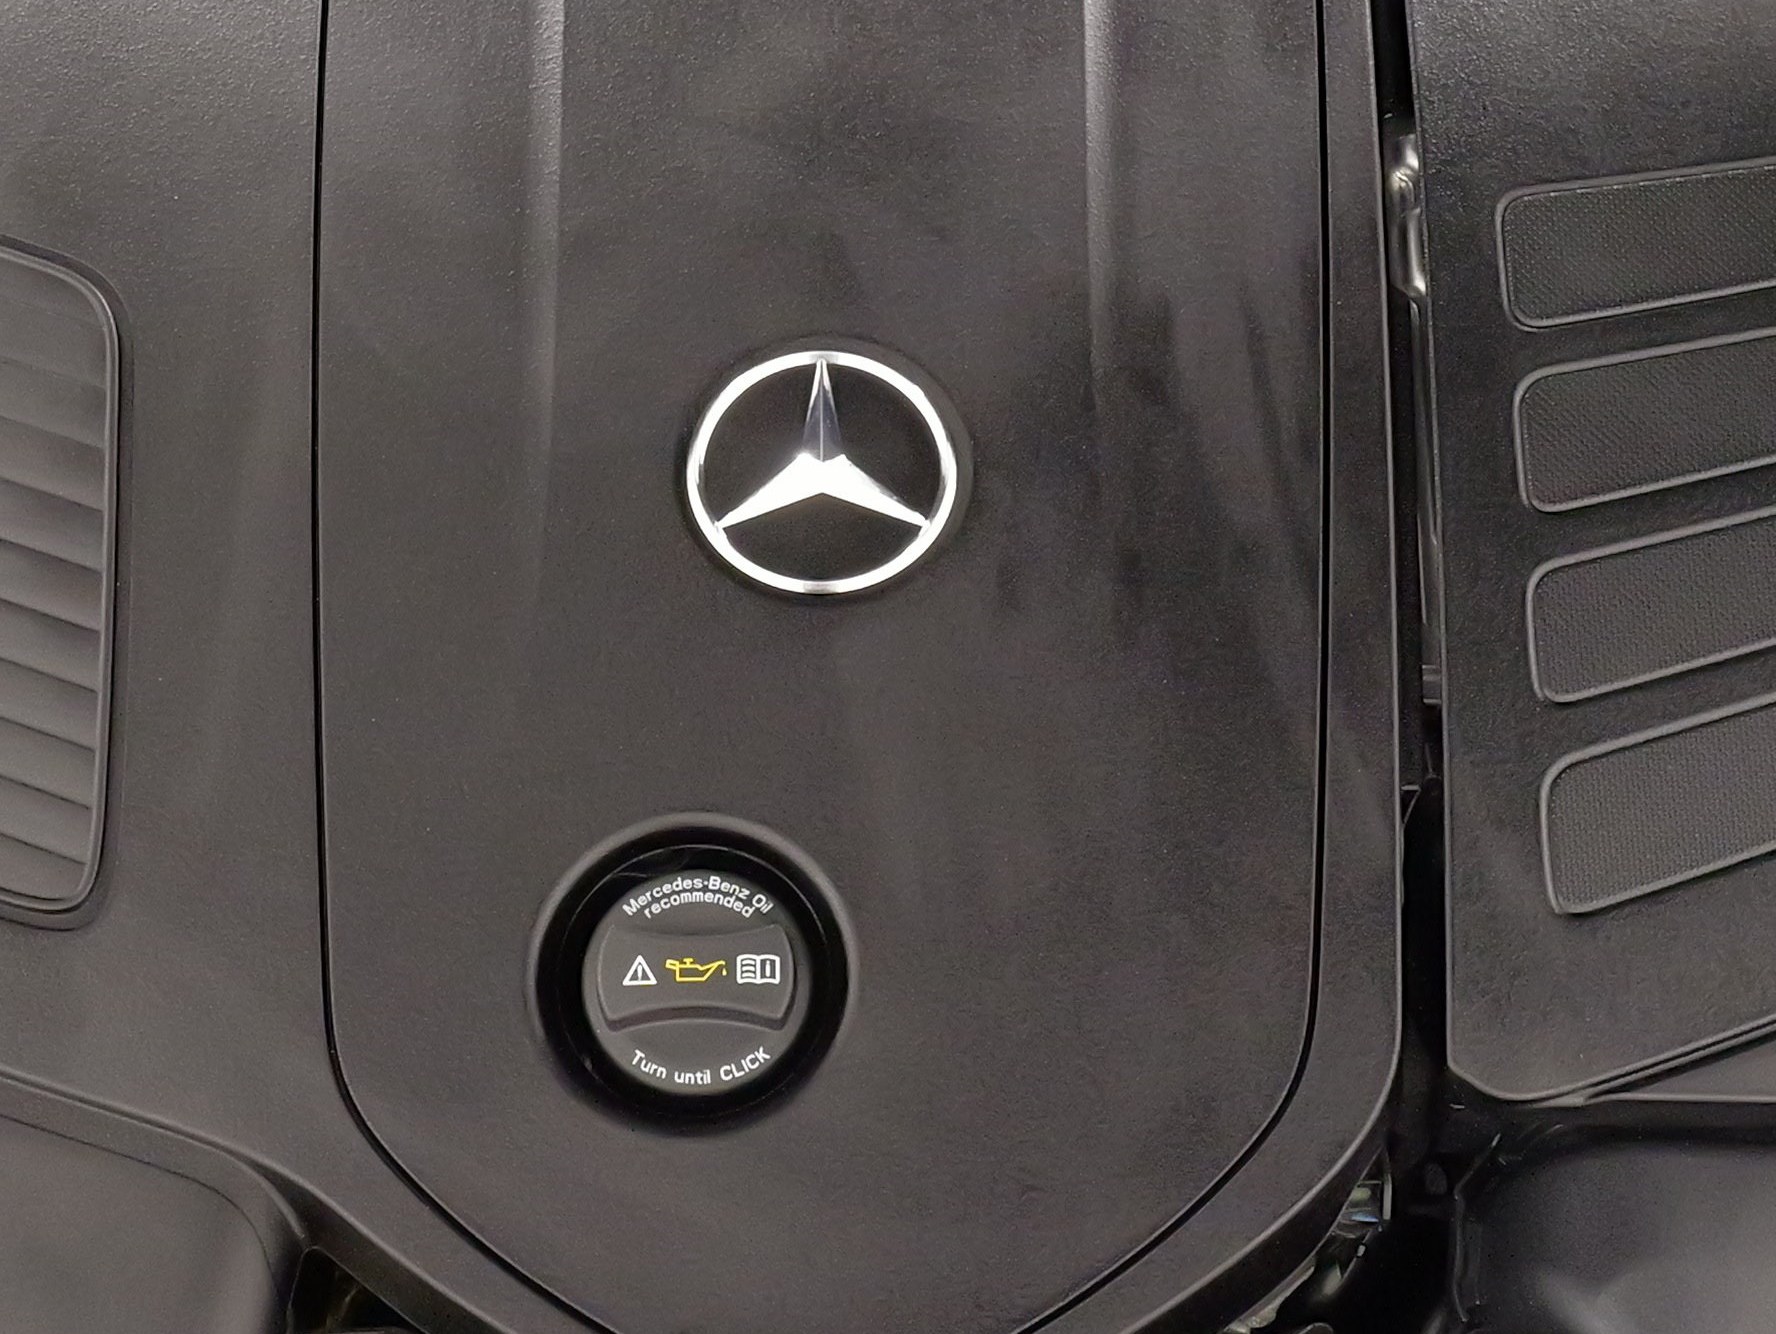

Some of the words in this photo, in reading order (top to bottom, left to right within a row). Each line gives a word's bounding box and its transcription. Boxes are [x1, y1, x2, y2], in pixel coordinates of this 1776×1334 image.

[622, 876, 750, 917] Mercedes-Benz
[752, 891, 774, 914] Oil
[644, 891, 756, 919] recommended
[631, 1050, 666, 1079] Turn
[674, 1069, 712, 1085] until
[720, 1047, 771, 1081] CLICK
